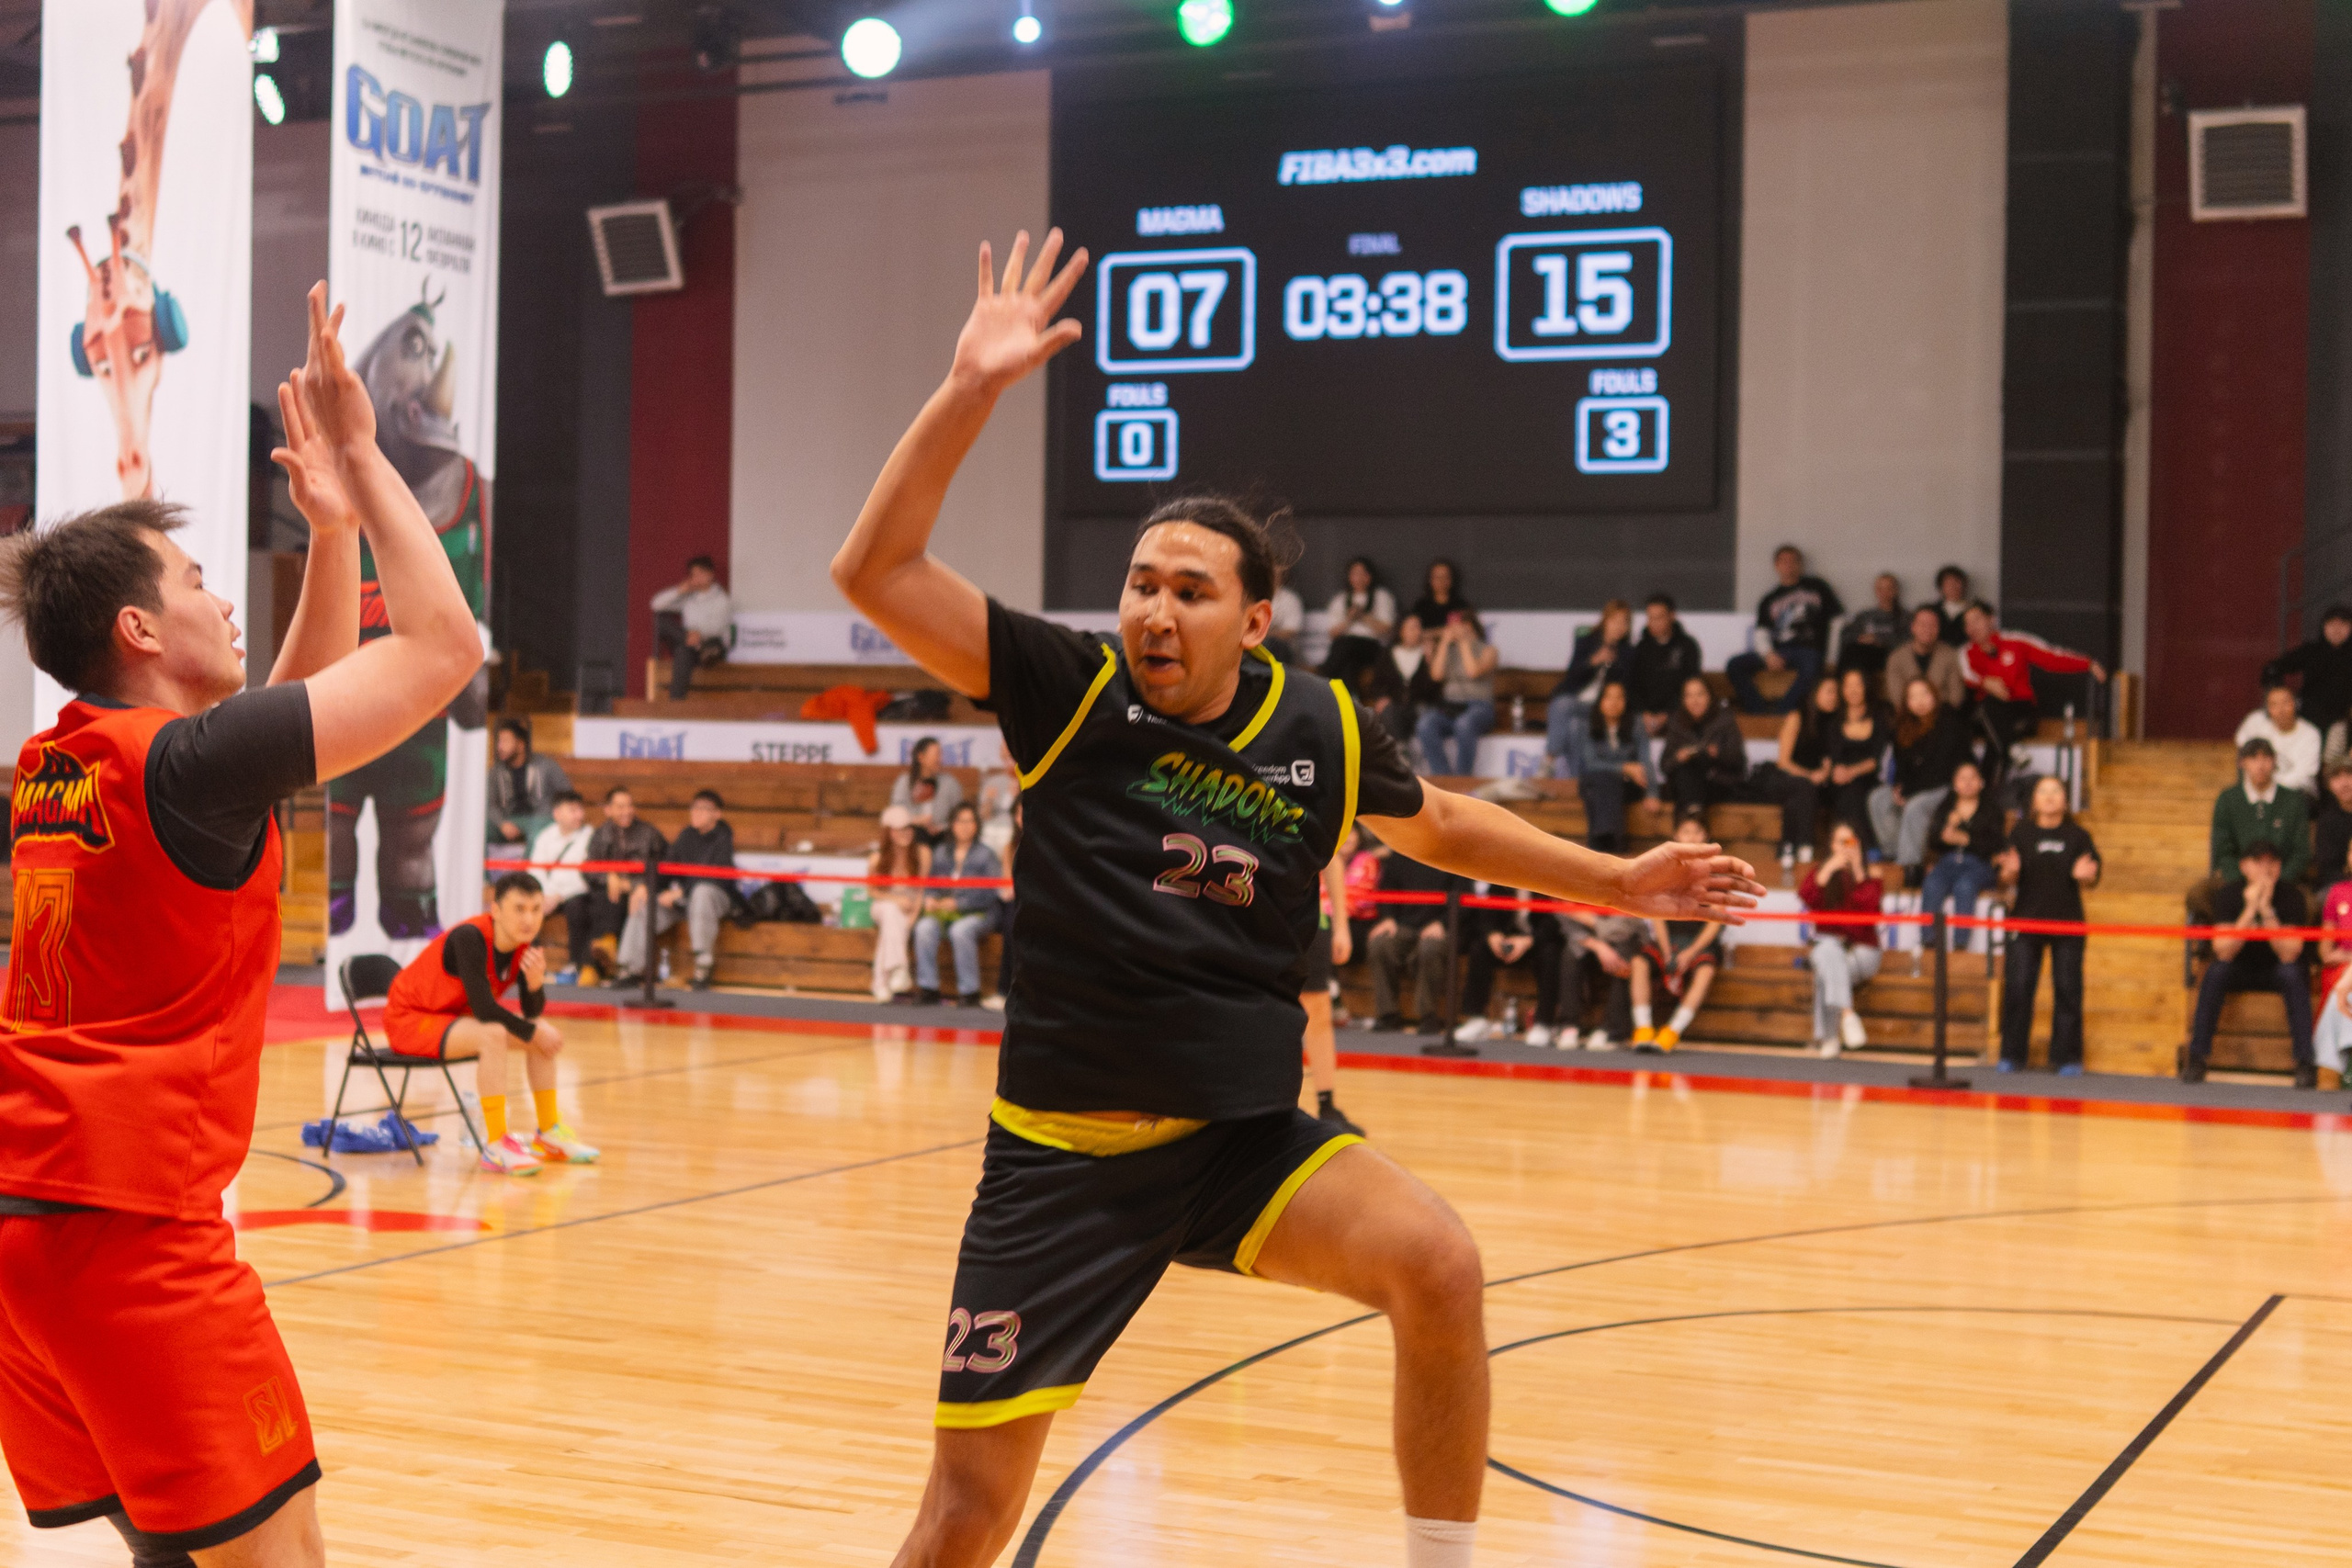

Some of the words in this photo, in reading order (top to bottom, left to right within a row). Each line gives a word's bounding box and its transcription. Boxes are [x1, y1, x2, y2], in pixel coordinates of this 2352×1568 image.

[346, 63, 492, 188] GOAT
[1278, 145, 1476, 185] FIBA3x3.com
[1136, 204, 1224, 236] MAGMA
[1520, 182, 1642, 218] SHADOWS
[401, 220, 423, 263] 12
[1347, 232, 1402, 256] FINAL
[1127, 269, 1229, 351] 07
[1283, 269, 1469, 341] 03:38
[1532, 251, 1634, 337] 15
[1106, 381, 1169, 408] FOULS
[1589, 367, 1657, 396] FOULS
[1118, 421, 1155, 467] 0
[1602, 409, 1641, 459] 3
[752, 741, 832, 763] STEPPE
[15, 773, 105, 837] MAGMA
[1152, 832, 1260, 908] 23
[942, 1306, 1022, 1373] 23
